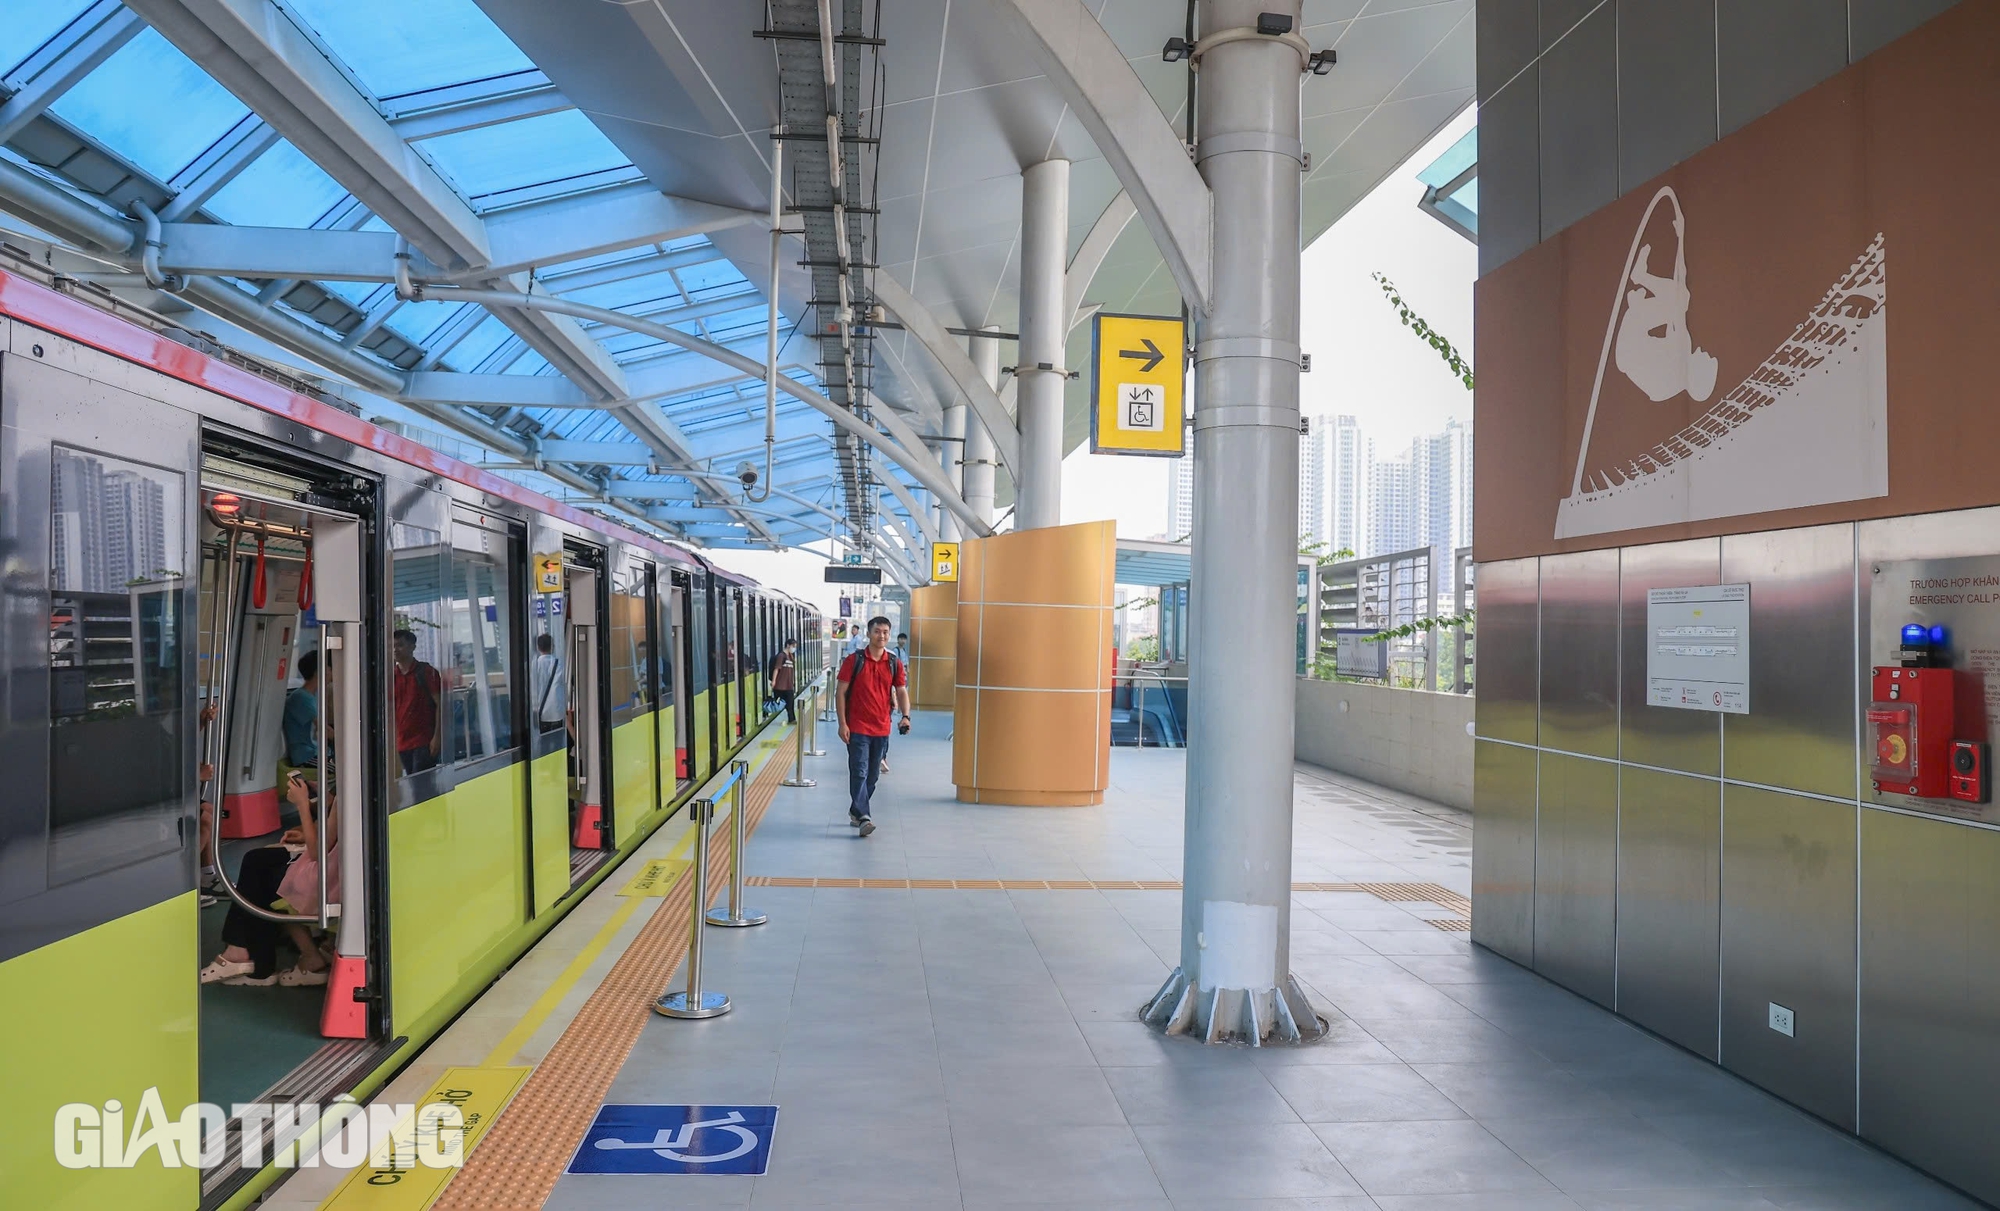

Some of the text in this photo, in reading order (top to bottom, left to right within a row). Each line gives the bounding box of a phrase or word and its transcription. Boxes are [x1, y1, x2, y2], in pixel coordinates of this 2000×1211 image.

[1910, 577, 1949, 589] TRƯỜNG
[1909, 593, 2000, 605] EMERGENCY CALL P
[464, 1112, 483, 1125] GAP
